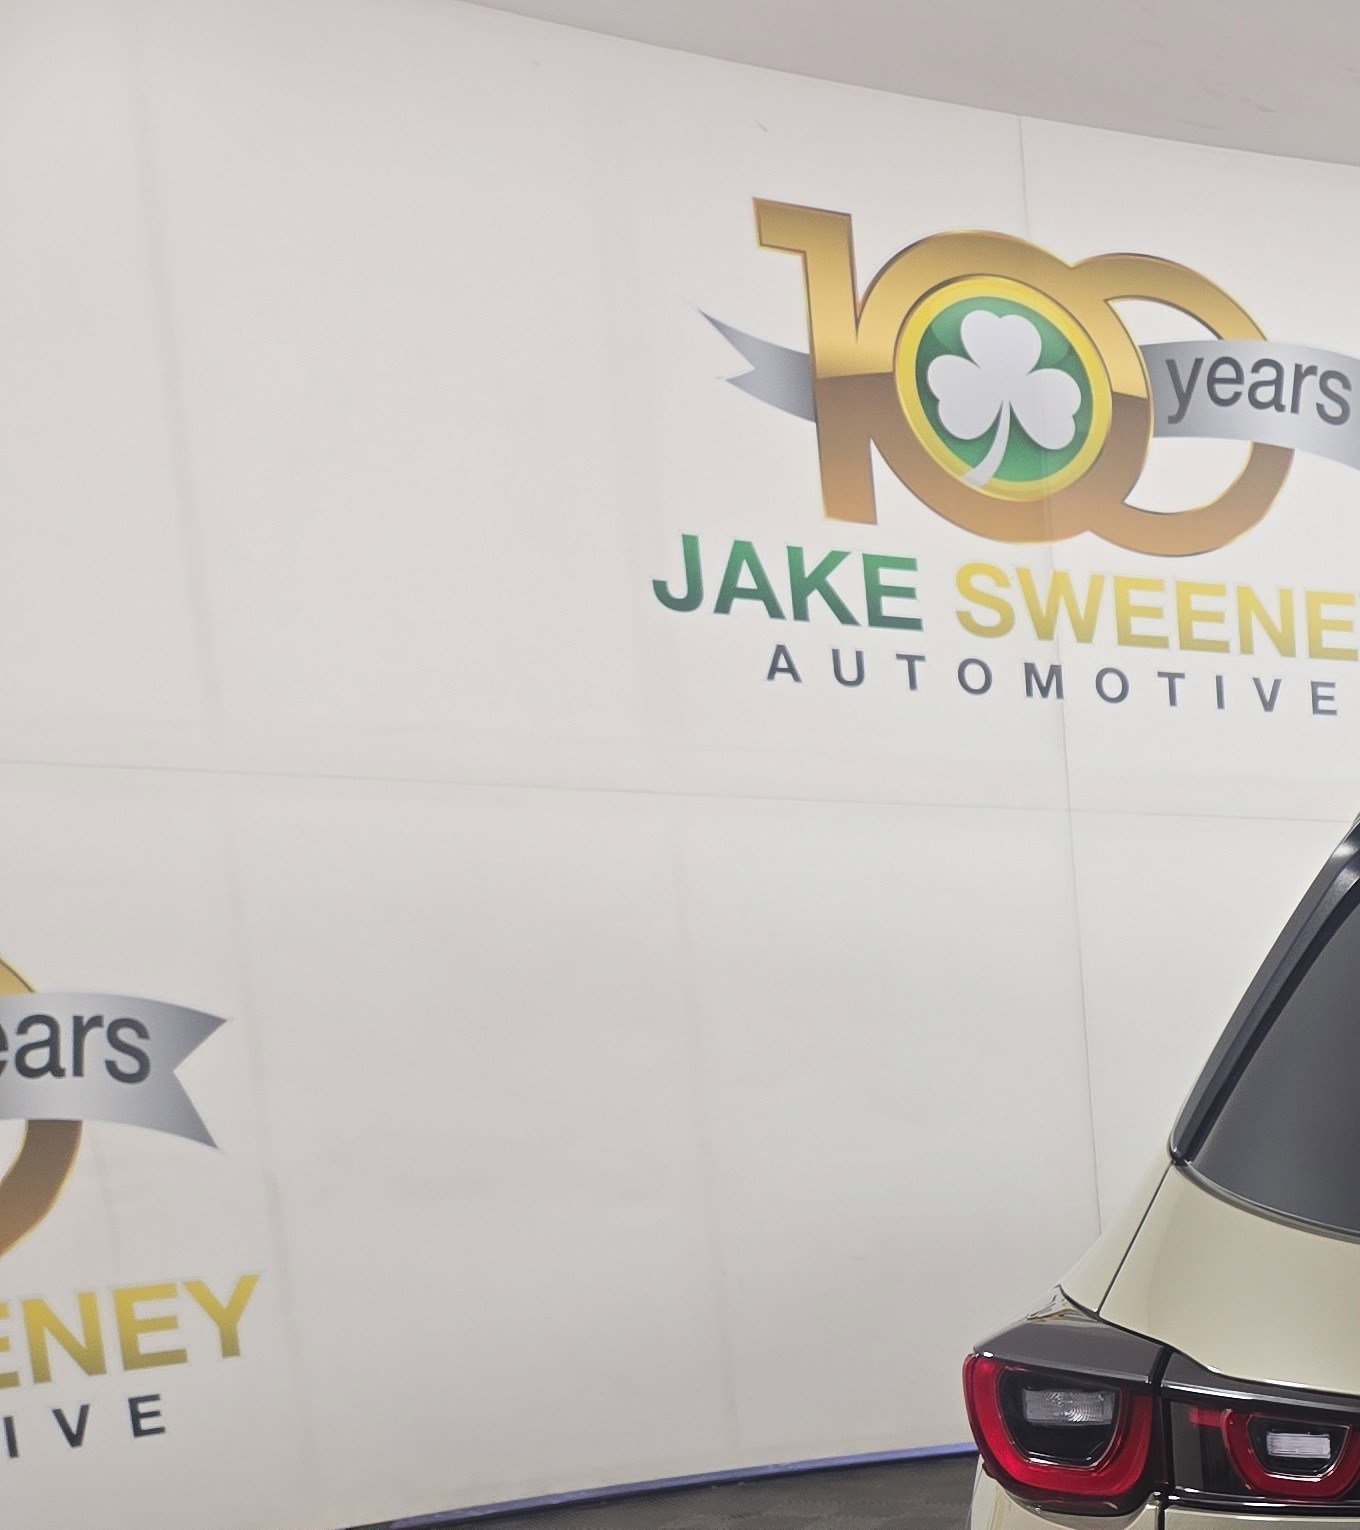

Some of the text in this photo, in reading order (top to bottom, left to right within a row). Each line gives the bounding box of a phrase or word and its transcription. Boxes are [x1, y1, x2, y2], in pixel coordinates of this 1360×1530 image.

[1166, 352, 1353, 425] years
[652, 533, 924, 633] JAKE
[766, 643, 1339, 717] AUTOMOTIVE
[0, 1012, 151, 1085] ars
